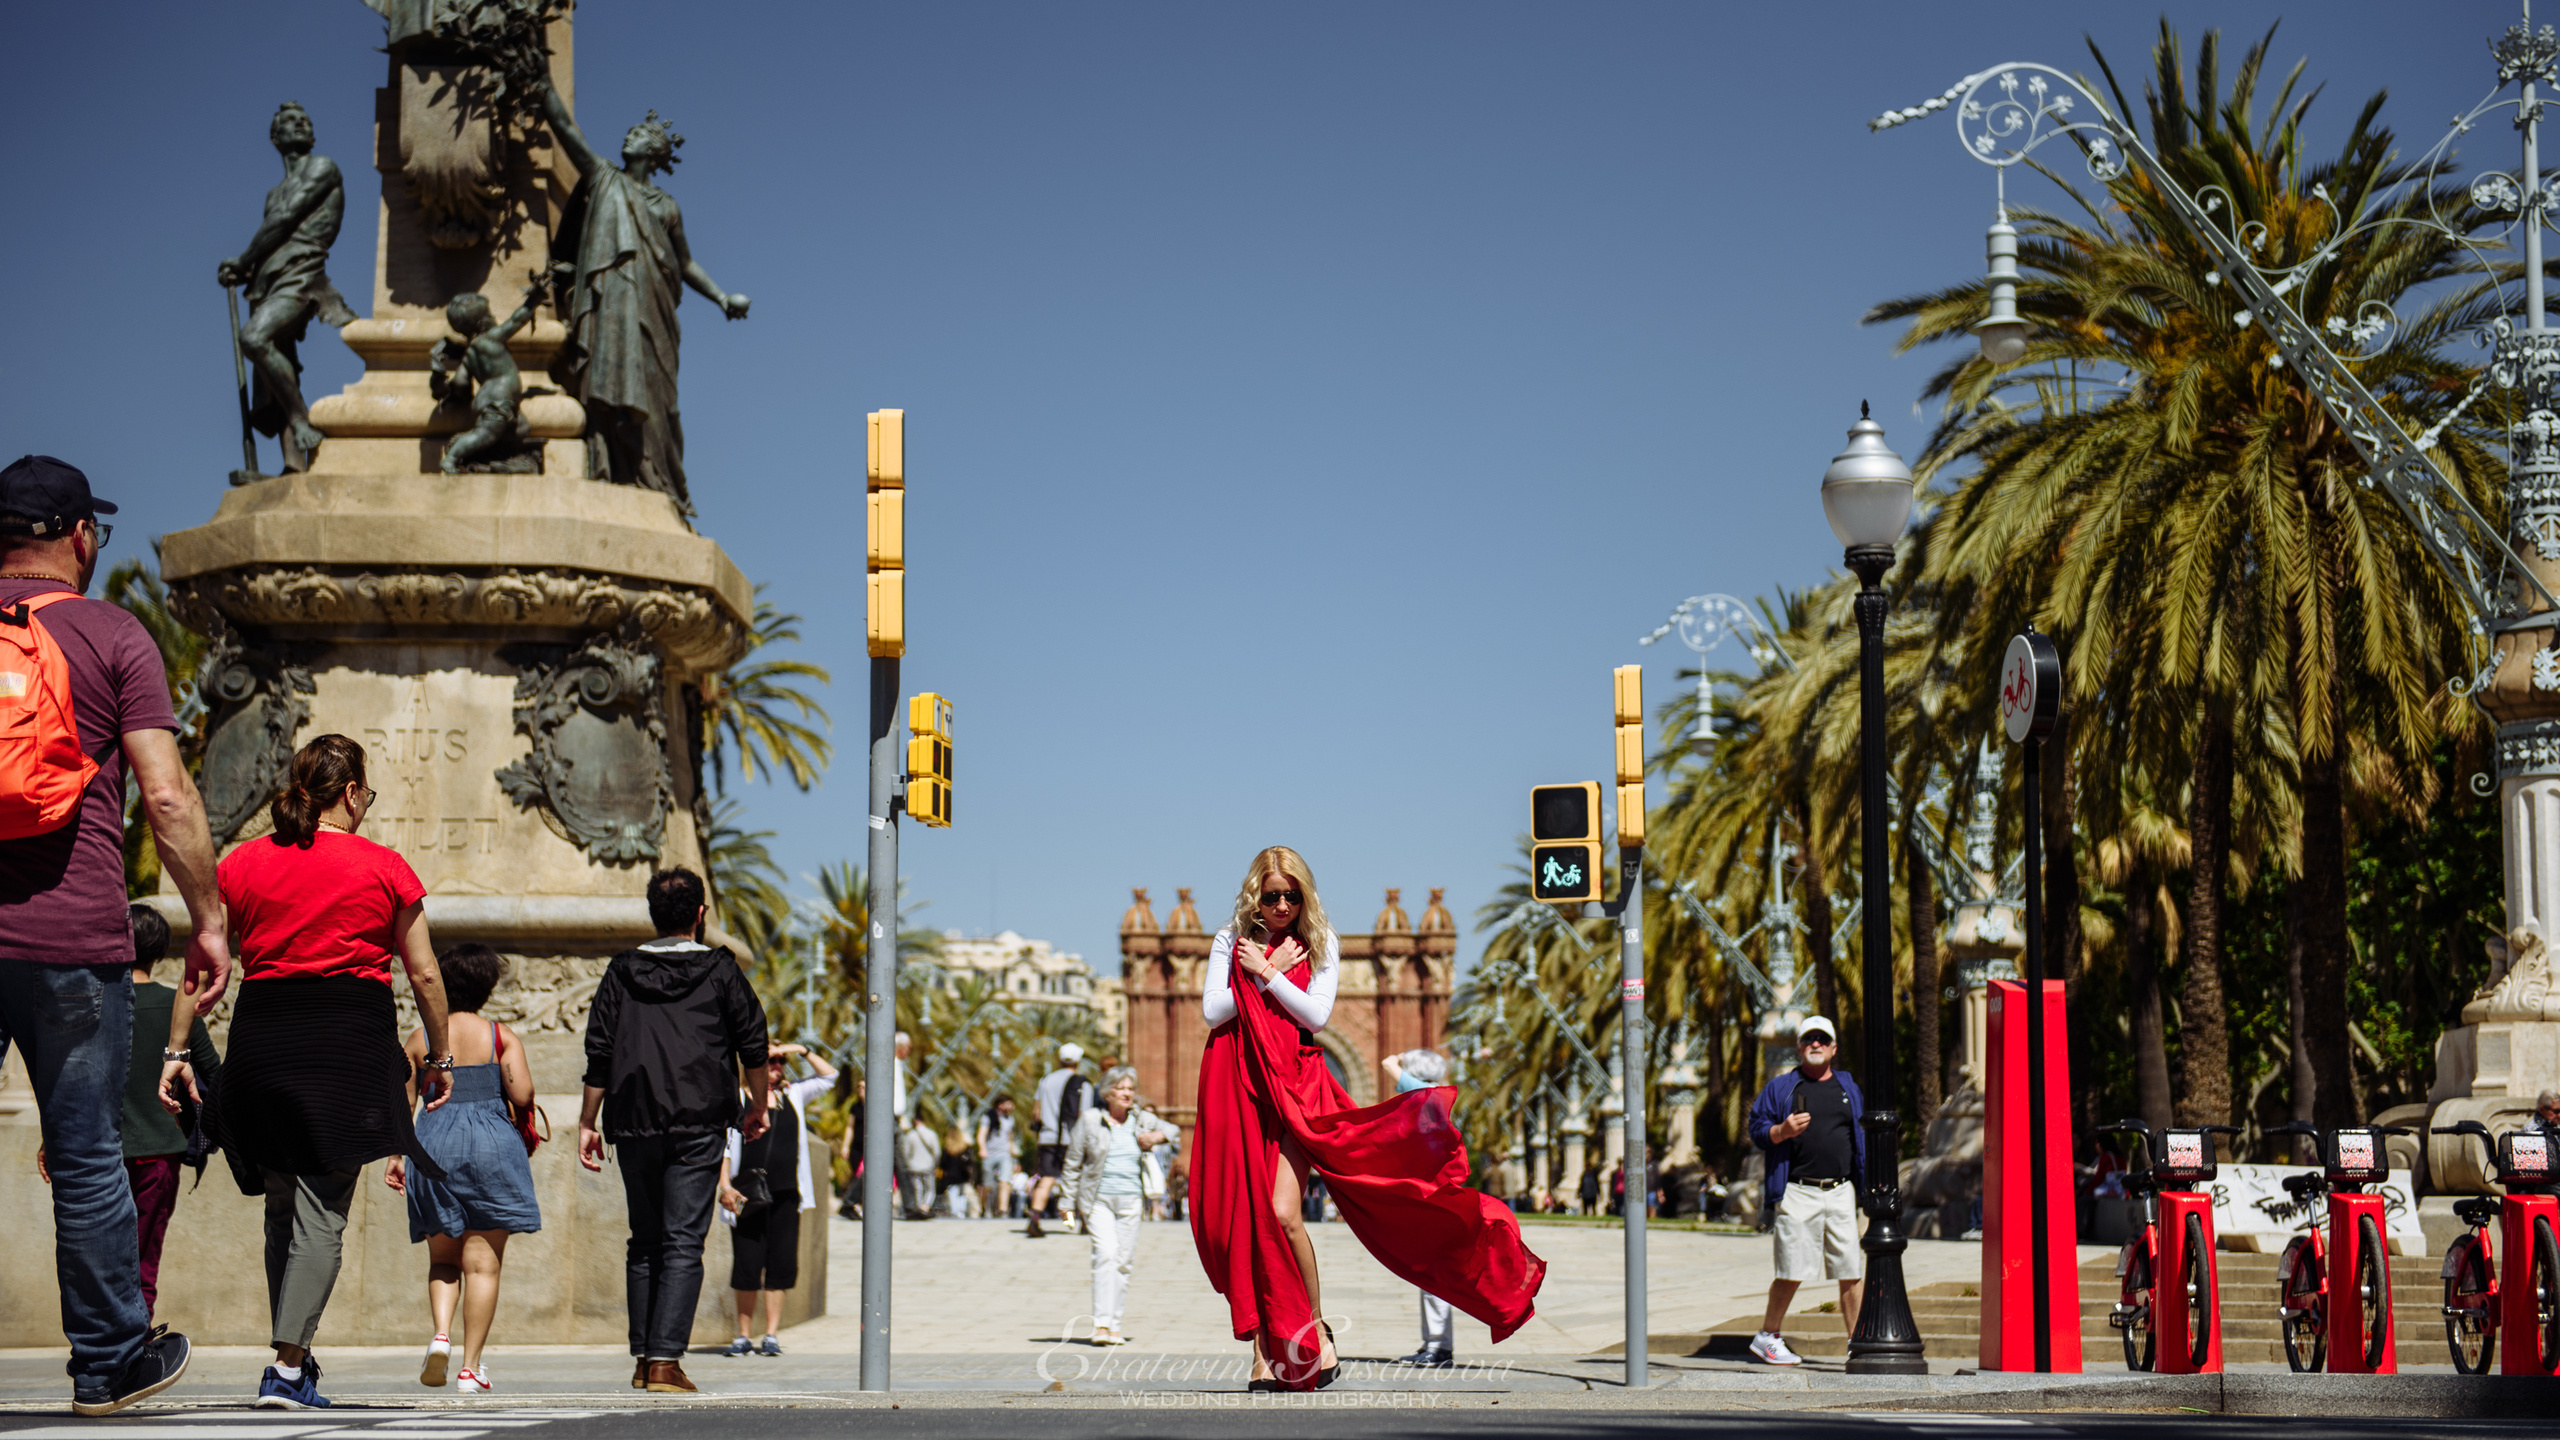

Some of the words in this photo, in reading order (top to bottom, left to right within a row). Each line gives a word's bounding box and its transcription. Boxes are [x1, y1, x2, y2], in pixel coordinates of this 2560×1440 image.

[403, 675, 431, 713] A
[363, 728, 468, 765] RIUS
[401, 776, 424, 805] Y
